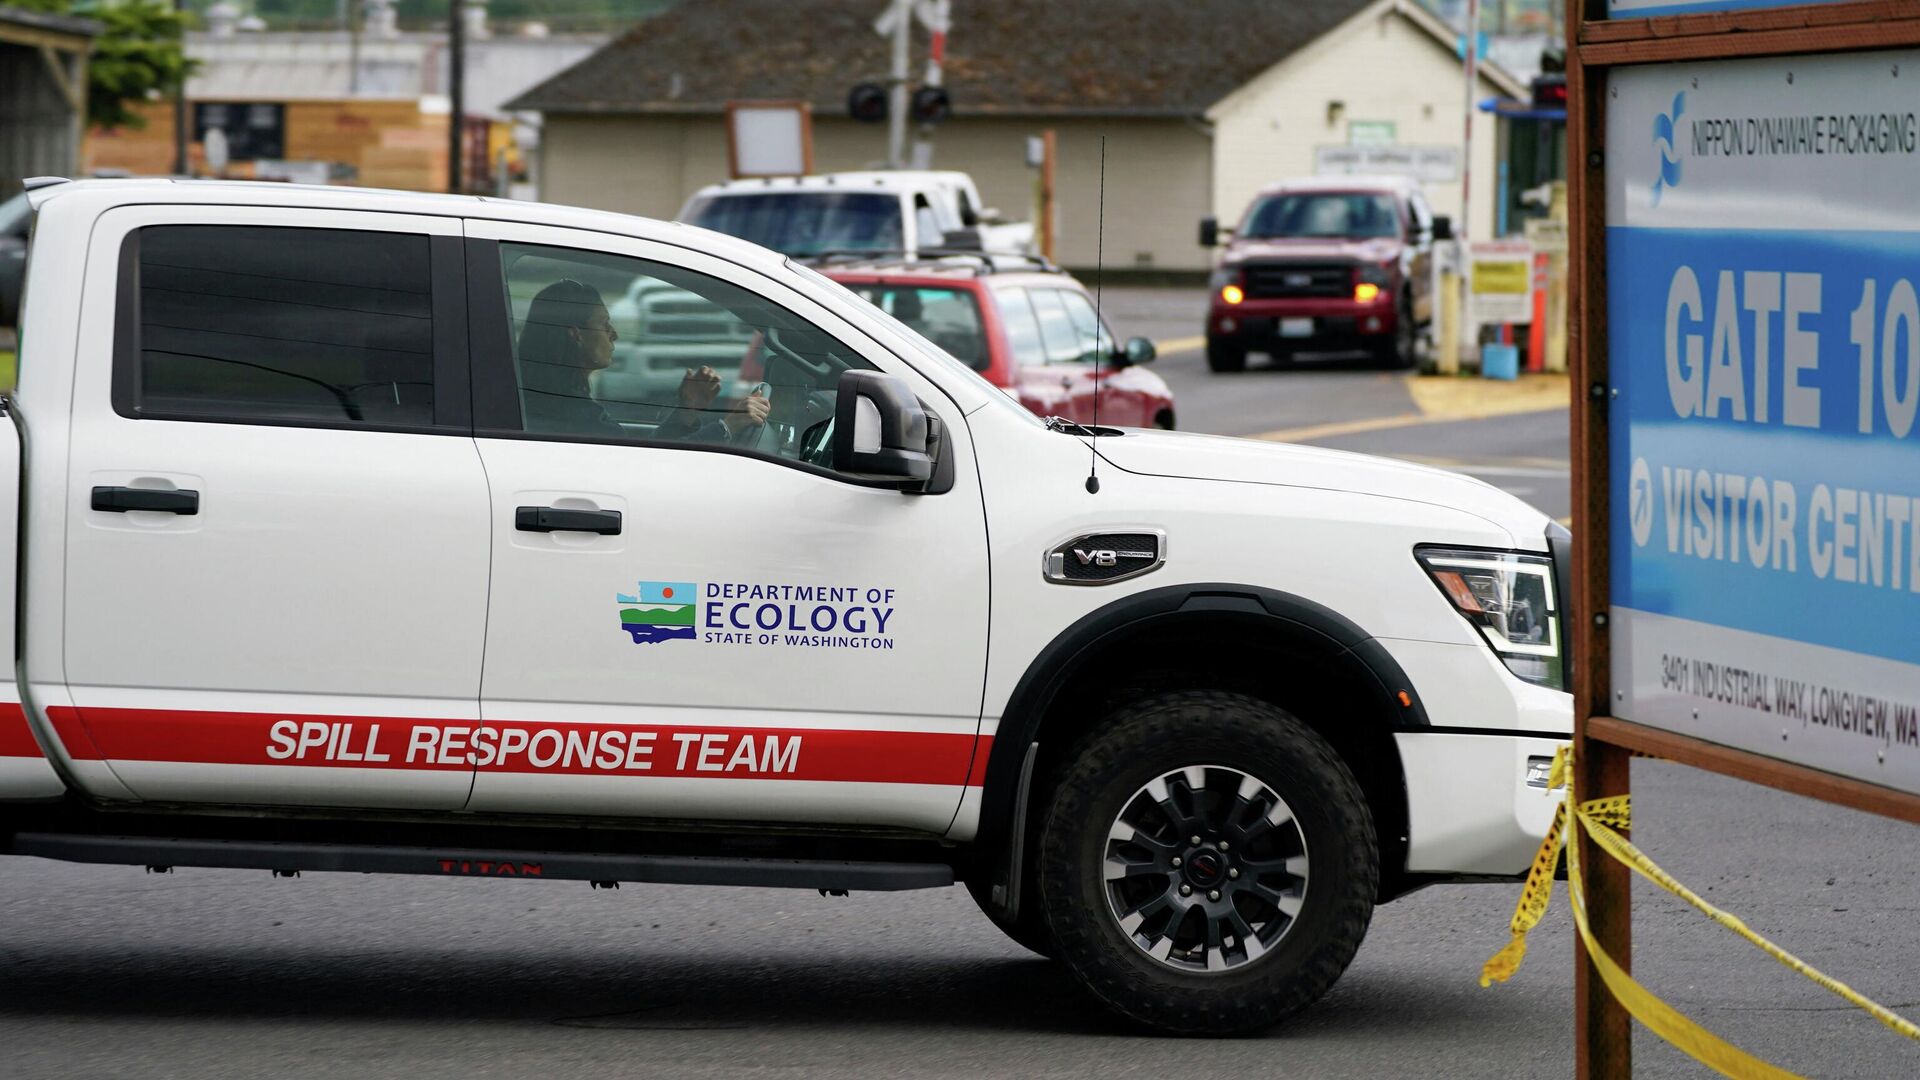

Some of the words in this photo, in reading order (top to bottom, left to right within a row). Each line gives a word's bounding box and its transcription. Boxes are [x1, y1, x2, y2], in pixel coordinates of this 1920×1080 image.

[1692, 118, 1742, 156] NIPPON
[1746, 116, 1824, 155] DYNAWAVE
[1828, 113, 1916, 154] PACKAGING
[1664, 265, 1822, 428] GATE
[1850, 277, 1920, 439] 10
[1662, 466, 1797, 572] VISITOR
[1073, 548, 1117, 567] V8
[706, 582, 858, 602] DEPARTMENT
[866, 588, 895, 604] OF
[705, 602, 894, 634] ECOLOGY
[705, 632, 752, 645] STATE
[759, 634, 779, 646] OF
[784, 635, 894, 650] WASHINGTON
[1662, 653, 1689, 694] 3401
[1693, 659, 1772, 713] INDUSTRIAL
[1774, 676, 1808, 728] WAY,
[1810, 684, 1891, 748] LONGVIEW,
[1894, 703, 1920, 748] WA
[265, 719, 391, 762] SPILL
[405, 726, 657, 769] RESPONSE
[672, 732, 802, 774] TEAM
[437, 859, 543, 877] TITAN
